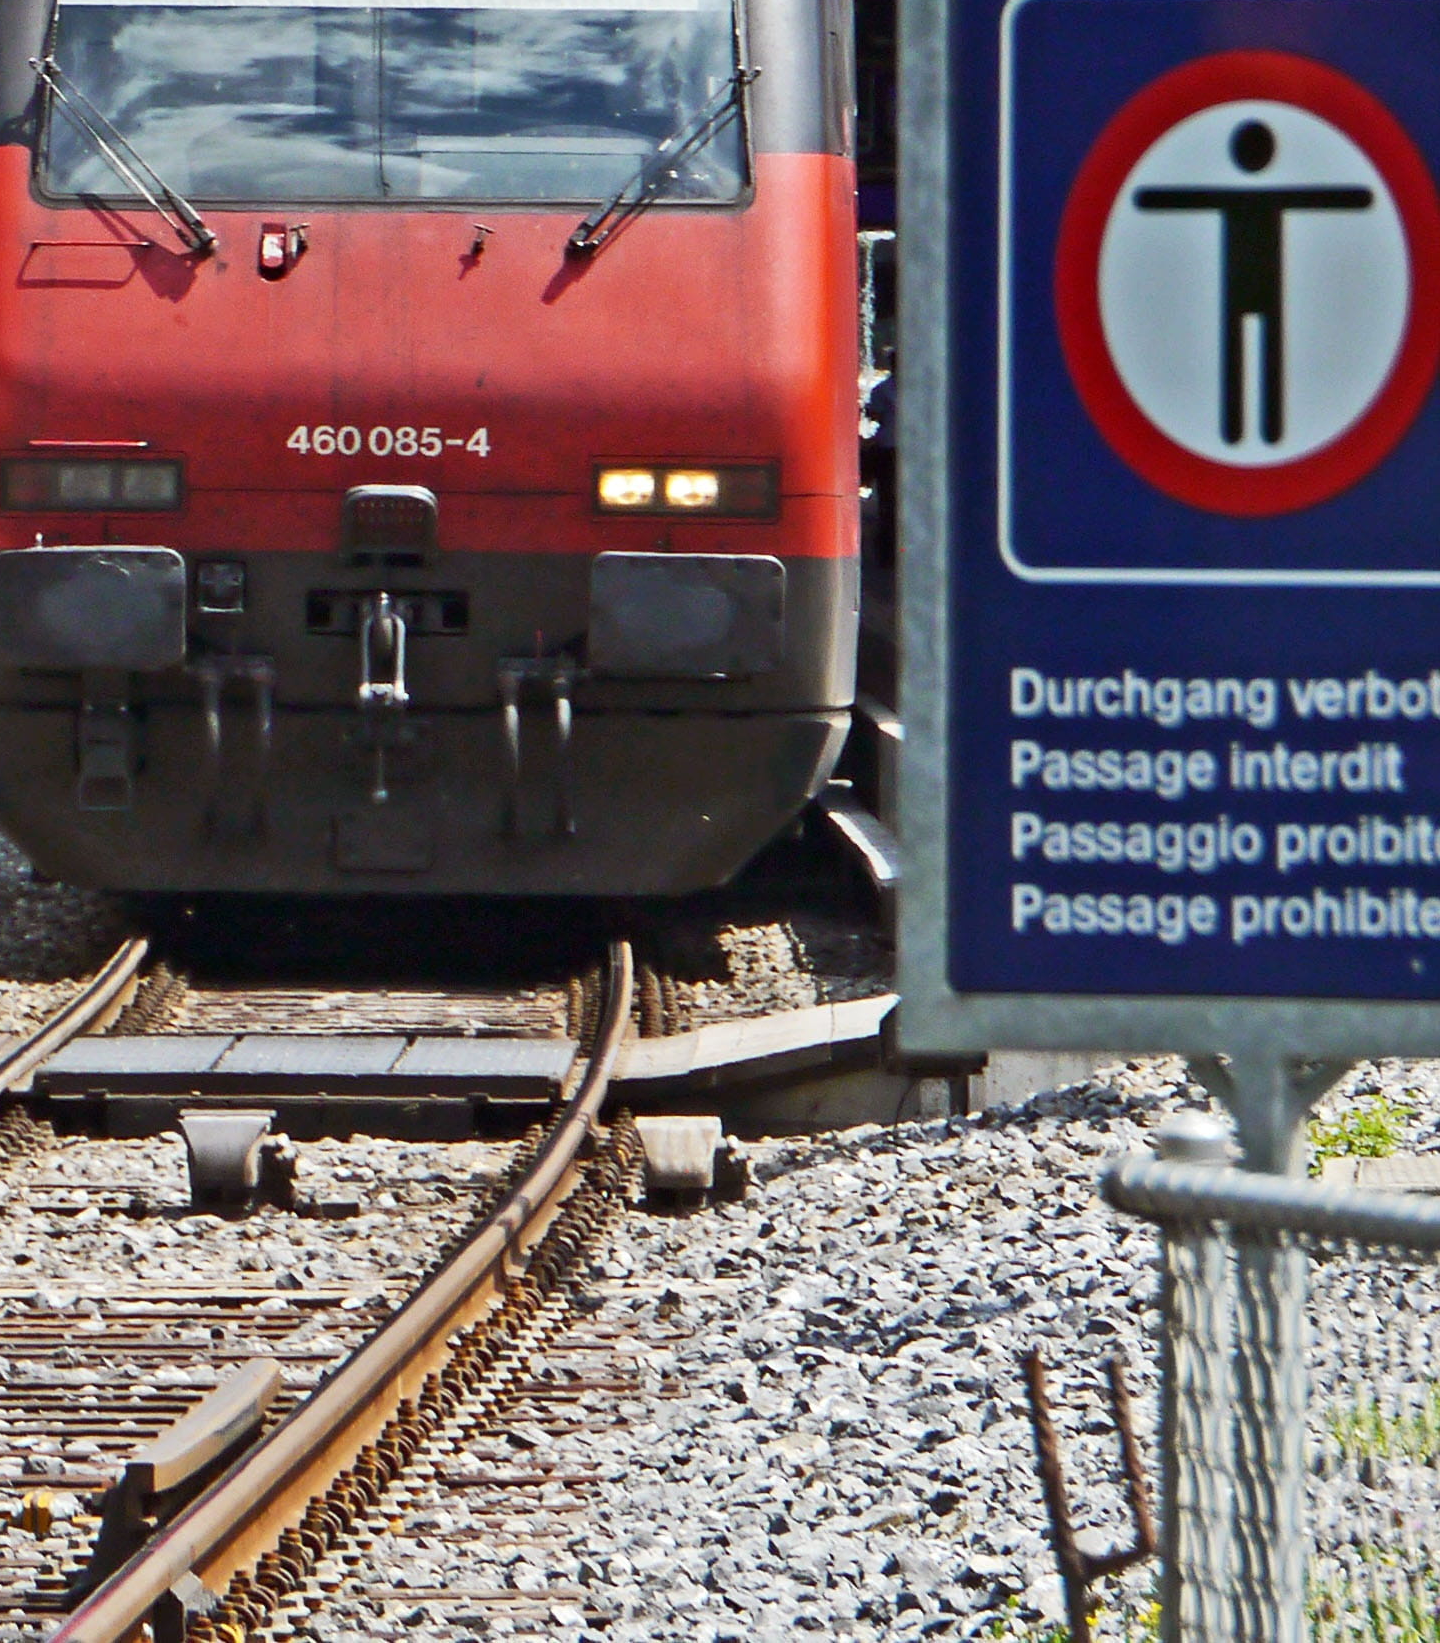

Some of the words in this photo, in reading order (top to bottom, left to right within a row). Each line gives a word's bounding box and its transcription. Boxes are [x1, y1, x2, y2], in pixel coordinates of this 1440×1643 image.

[286, 425, 363, 456] 460
[368, 426, 491, 458] 085-4
[1009, 666, 1278, 728] Durchgang
[1010, 739, 1218, 800] Passage
[1229, 741, 1406, 792] interdit
[1010, 811, 1265, 873] Passaggio
[1276, 814, 1440, 874] proibit
[1010, 883, 1218, 945] Passage
[1231, 886, 1440, 946] prohibite
